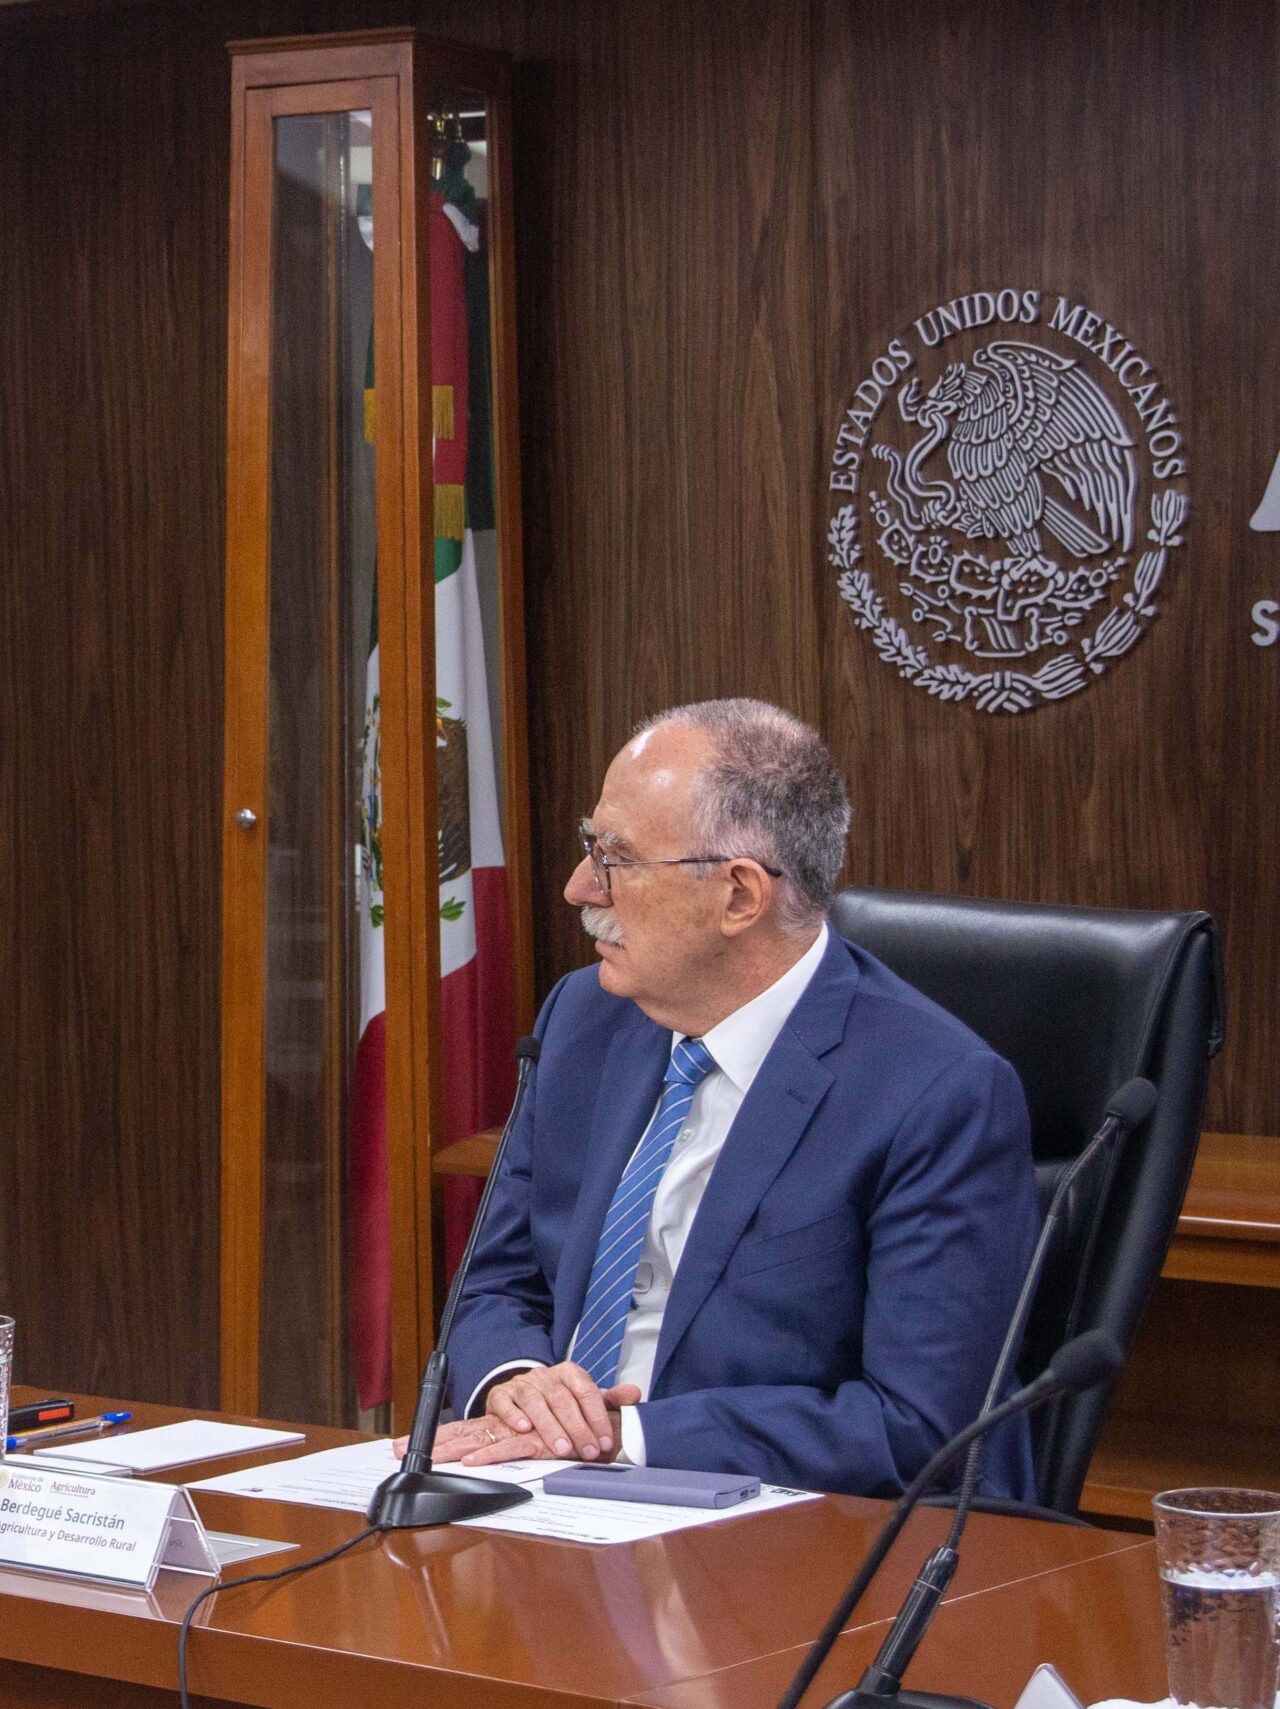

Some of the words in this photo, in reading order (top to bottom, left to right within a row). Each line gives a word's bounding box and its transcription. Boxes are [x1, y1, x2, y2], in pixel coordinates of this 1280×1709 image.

[829, 338, 911, 494] ESTADOS
[913, 289, 1041, 347] UNIDOS
[1048, 296, 1186, 480] MEXICANOS
[8, 1478, 42, 1493] México
[50, 1480, 96, 1496] Agricultura
[0, 1498, 63, 1521] Berdegué
[64, 1507, 125, 1531] Sacristán
[48, 1530, 56, 1542] y
[56, 1529, 108, 1548] Desarrollo
[109, 1537, 137, 1552] Rural
